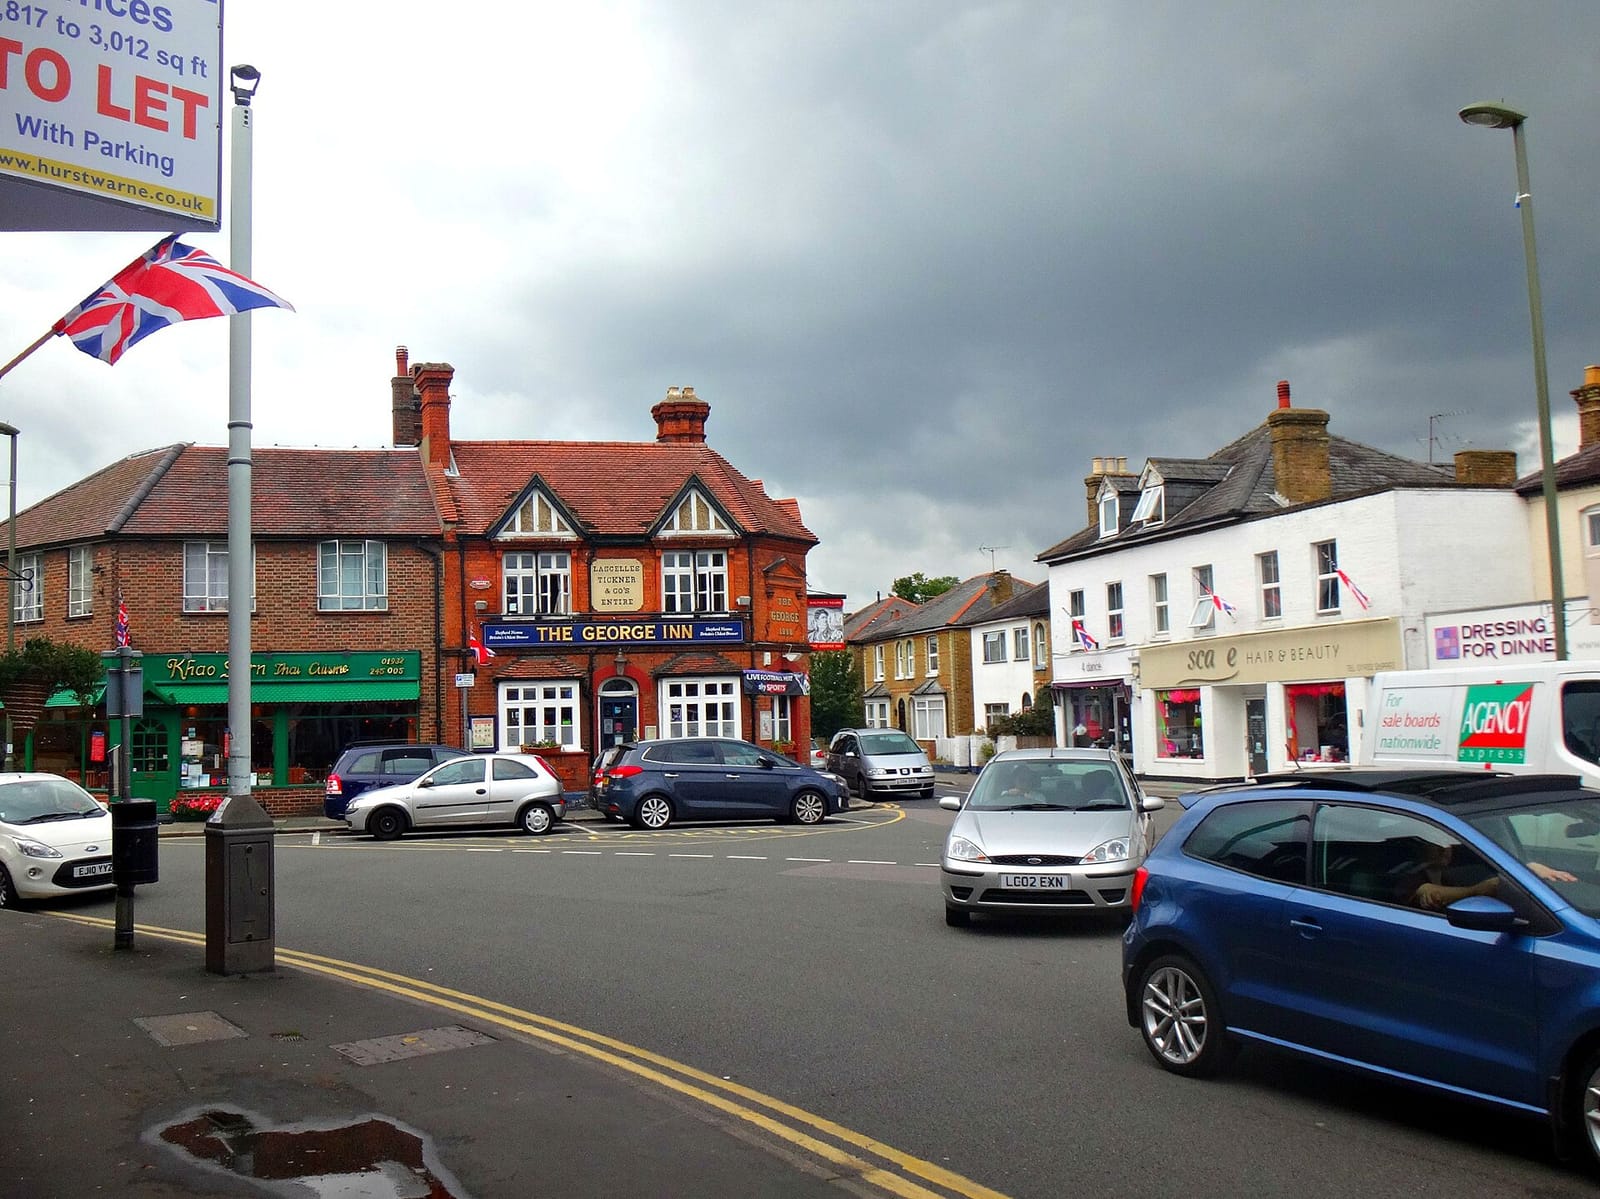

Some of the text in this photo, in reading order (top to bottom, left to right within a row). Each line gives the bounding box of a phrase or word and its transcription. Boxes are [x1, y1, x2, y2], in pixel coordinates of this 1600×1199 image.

[56, 16, 80, 38] to
[89, 25, 149, 60] 3,012
[157, 50, 183, 76] sq
[191, 56, 208, 78] ft
[0, 36, 209, 140] TO LET
[16, 113, 174, 177] With Parking
[598, 576, 636, 584] TICKNER
[771, 611, 800, 622] GEORGE
[536, 624, 693, 641] THE GEORGE INN
[1461, 618, 1545, 640] DRESSING
[1246, 650, 1274, 664] HAIR
[1278, 650, 1287, 662] &
[1290, 644, 1339, 661] BEAUTY
[1462, 637, 1556, 659] FOR DINNE
[167, 658, 216, 680] Khao
[274, 663, 301, 675] Thai
[369, 667, 385, 675] 245
[1385, 693, 1403, 707] For
[1382, 713, 1441, 728] sale boards
[1462, 701, 1530, 734] AGENCY
[1380, 734, 1441, 750] nationwide
[1459, 749, 1525, 760] express
[1040, 876, 1063, 887] EXN
